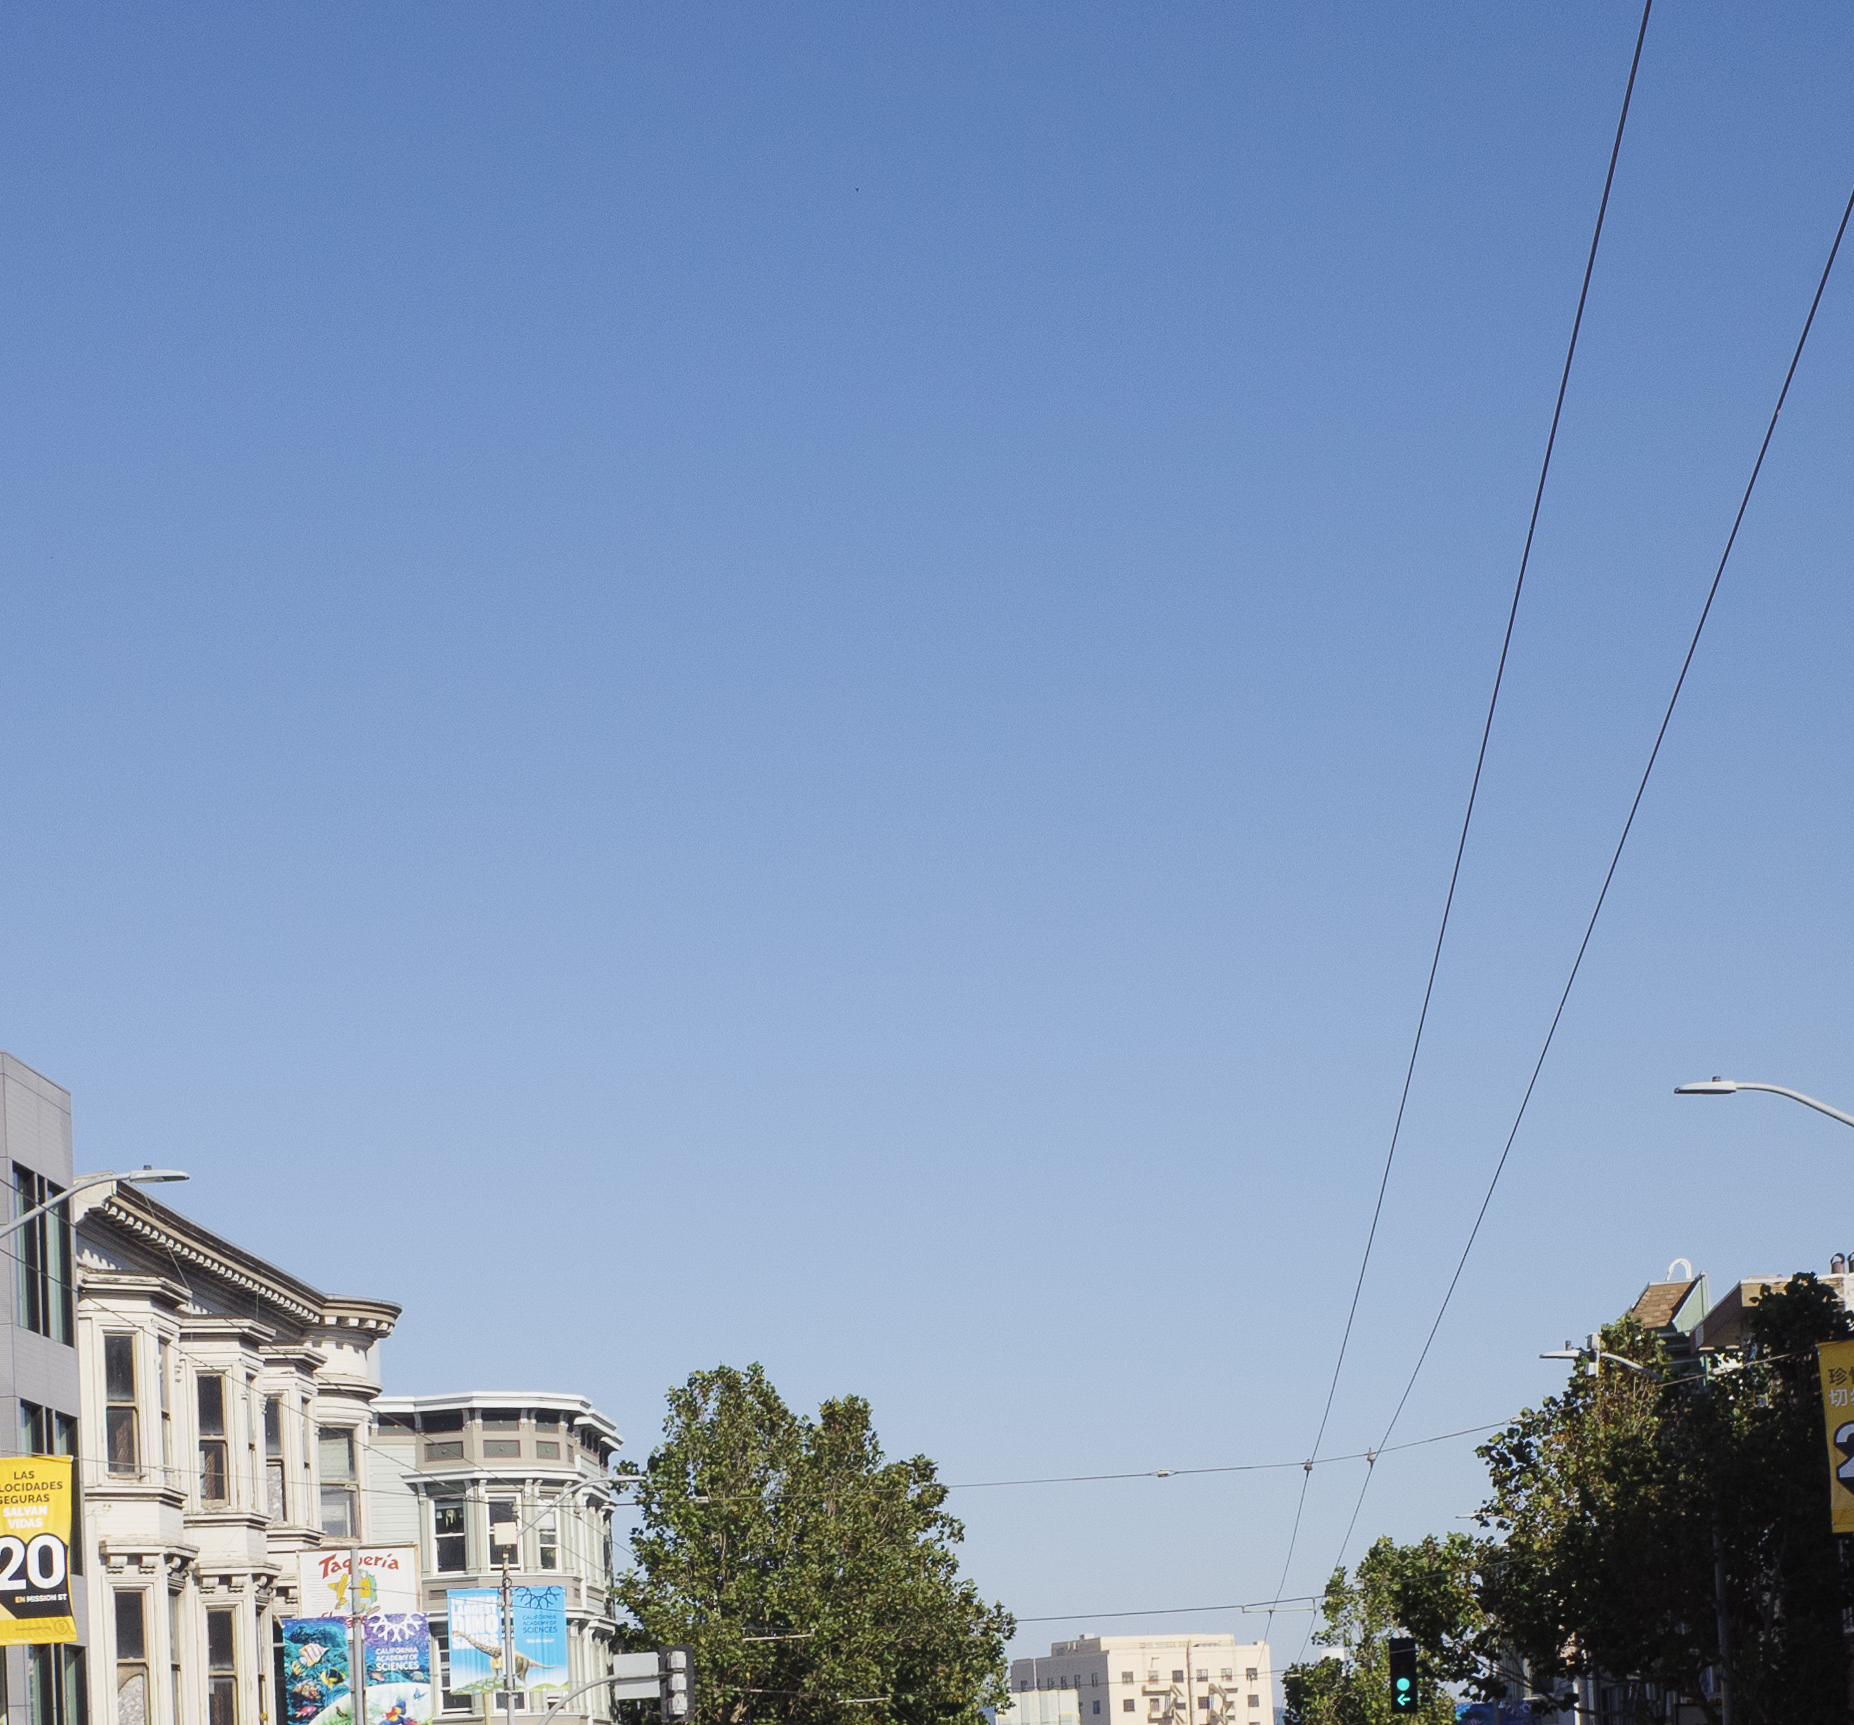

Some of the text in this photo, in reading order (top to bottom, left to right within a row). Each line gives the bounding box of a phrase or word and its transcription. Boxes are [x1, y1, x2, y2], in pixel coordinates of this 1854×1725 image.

[14, 1471, 35, 1480] LAS
[3, 1505, 48, 1518] SALVAN
[7, 1517, 43, 1529] VIDAS
[26, 1593, 57, 1602] MISSION
[57, 1593, 68, 1601] ST
[375, 1646, 419, 1655] CALIFORNIA
[375, 1660, 420, 1672] SCIENCES
